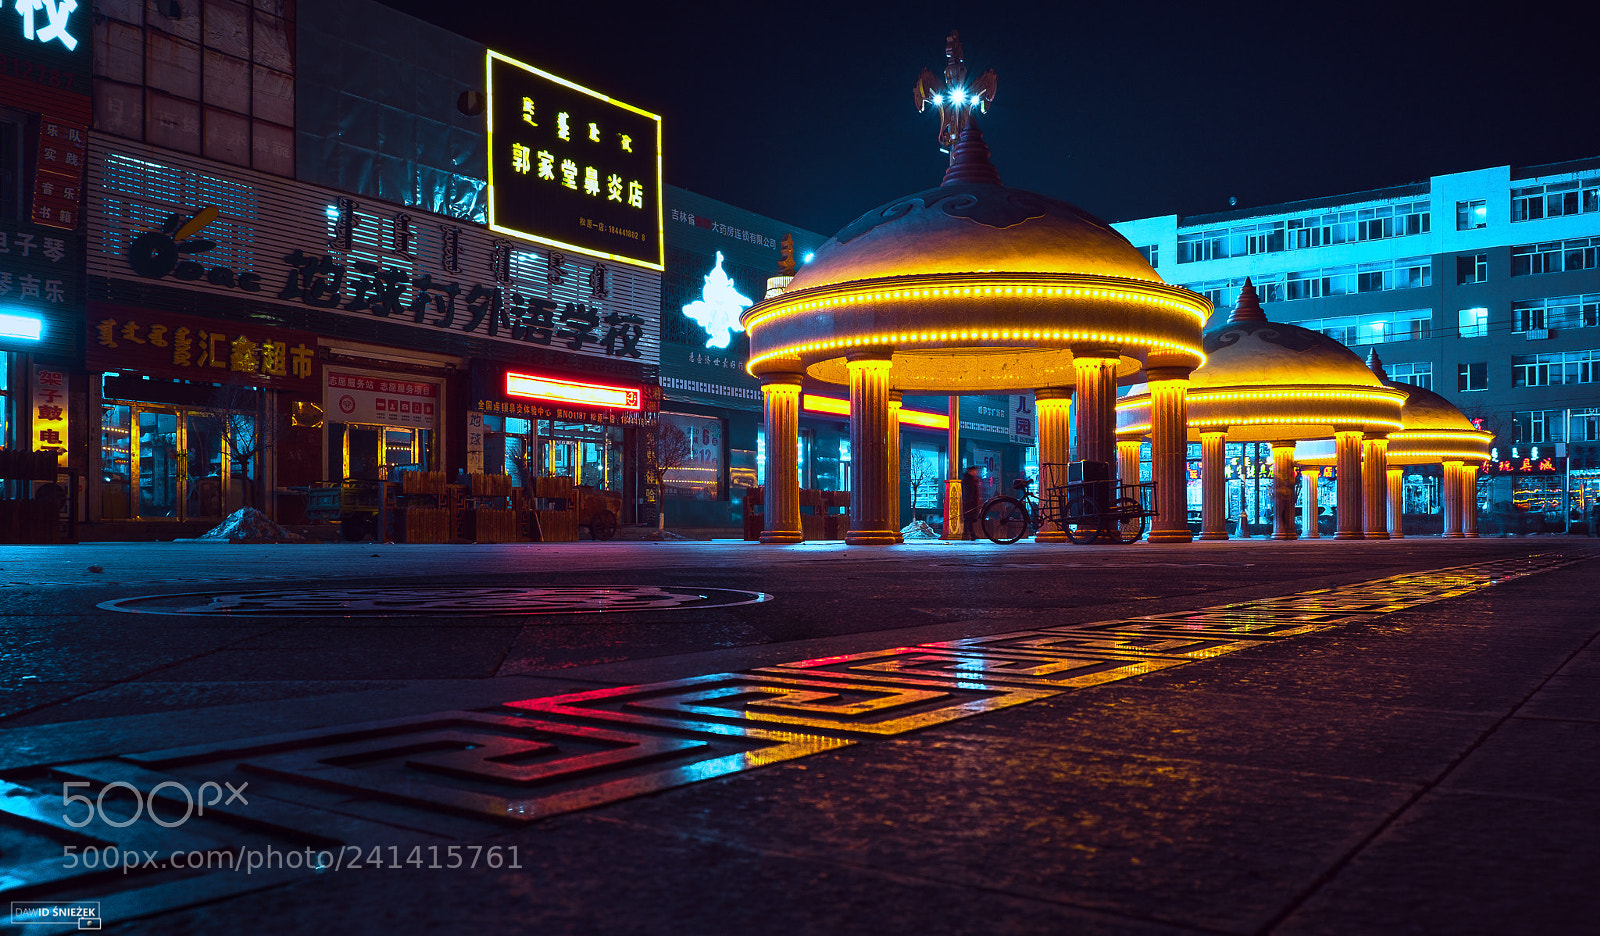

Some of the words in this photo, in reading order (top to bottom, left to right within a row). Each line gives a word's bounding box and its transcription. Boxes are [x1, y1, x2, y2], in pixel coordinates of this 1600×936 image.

[44, 147, 80, 167] 实践
[41, 182, 76, 201] 音乐
[512, 142, 643, 209] 郭家堂鼻炎店
[278, 249, 645, 358] 地球村外语学校
[197, 329, 315, 379] 汇鑫超市
[328, 376, 374, 390] 志愿服务站
[380, 381, 430, 395] 志愿服务项目
